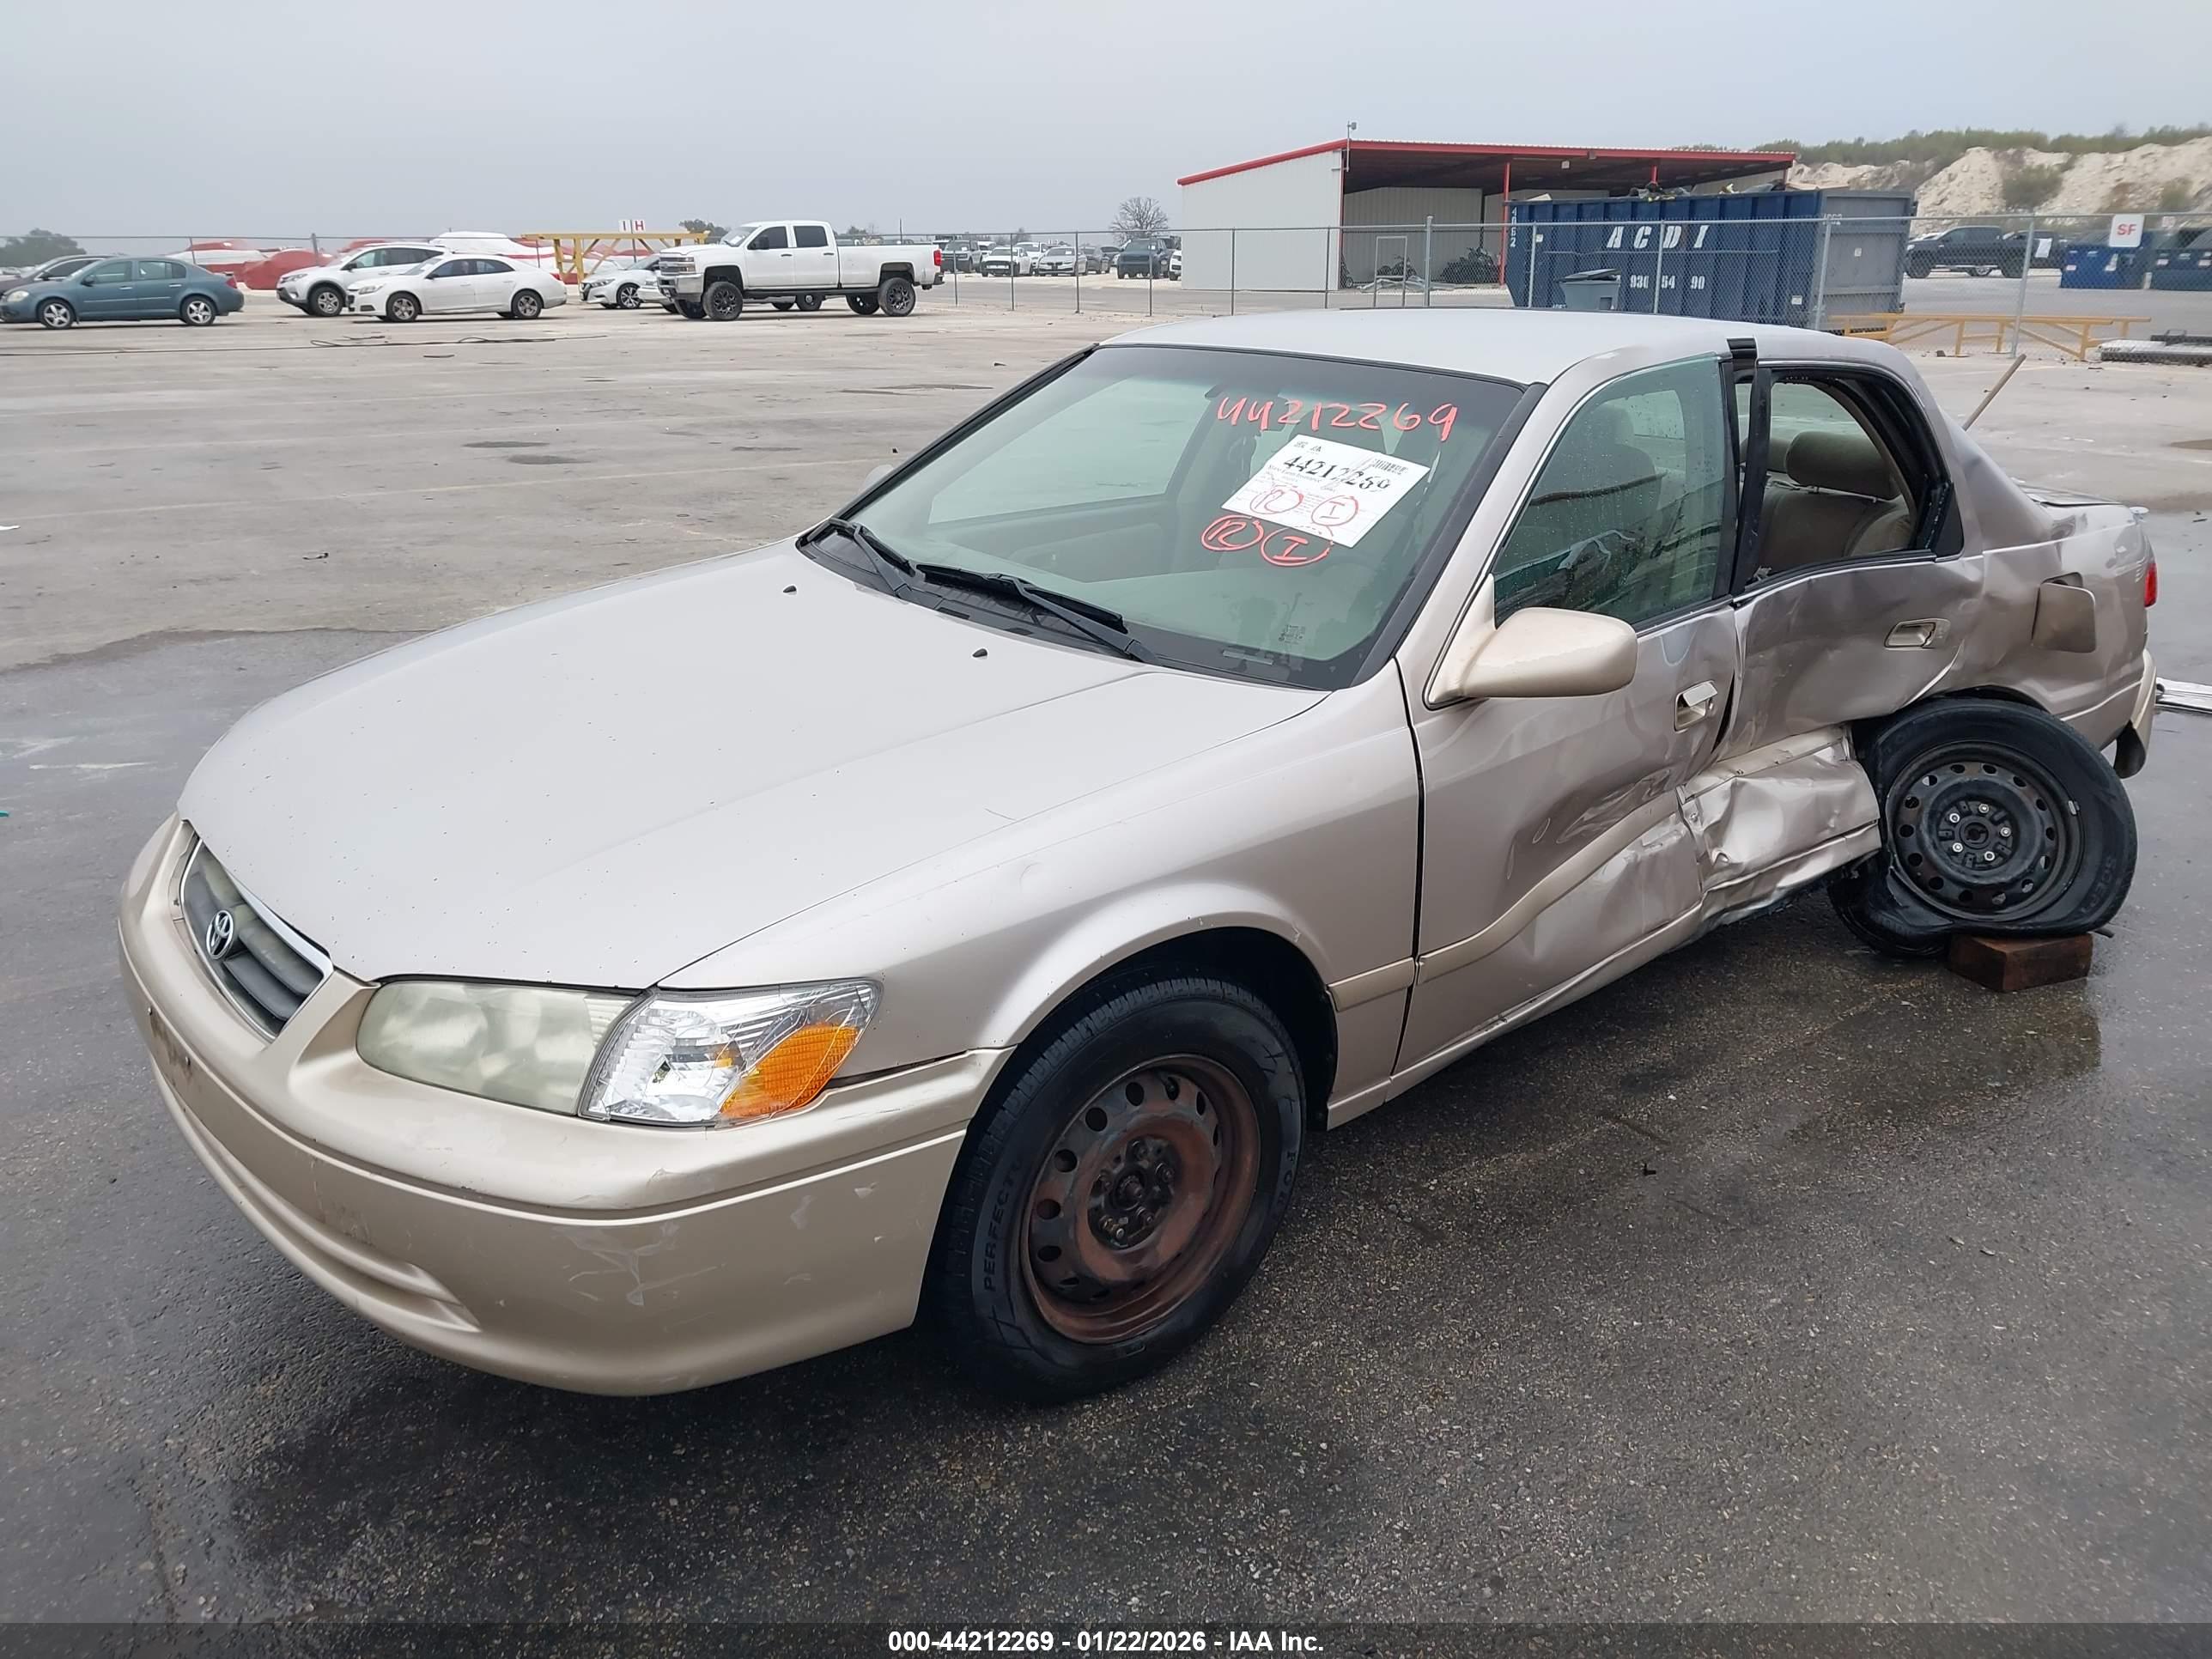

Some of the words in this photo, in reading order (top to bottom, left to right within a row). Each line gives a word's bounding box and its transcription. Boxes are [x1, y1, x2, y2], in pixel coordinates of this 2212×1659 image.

[635, 220, 644, 231] H
[2117, 223, 2137, 235] SF
[1216, 397, 1458, 441] 44212269
